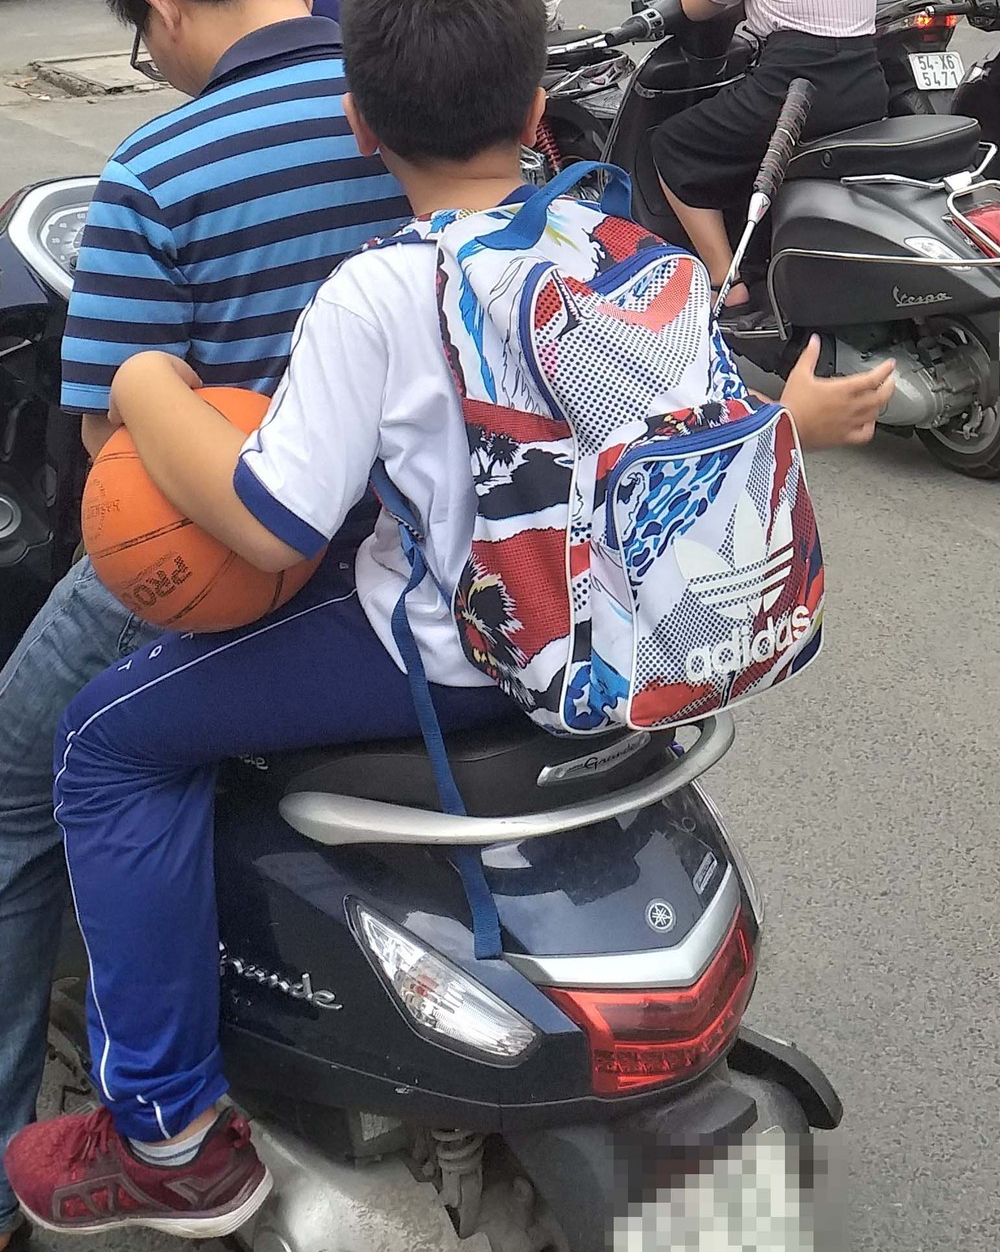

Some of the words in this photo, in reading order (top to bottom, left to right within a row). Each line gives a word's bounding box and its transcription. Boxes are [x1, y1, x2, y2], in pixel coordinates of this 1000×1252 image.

[917, 54, 955, 71] 54-X6
[922, 70, 959, 87] 5471
[892, 285, 953, 307] Vespa
[685, 604, 812, 682] adidas
